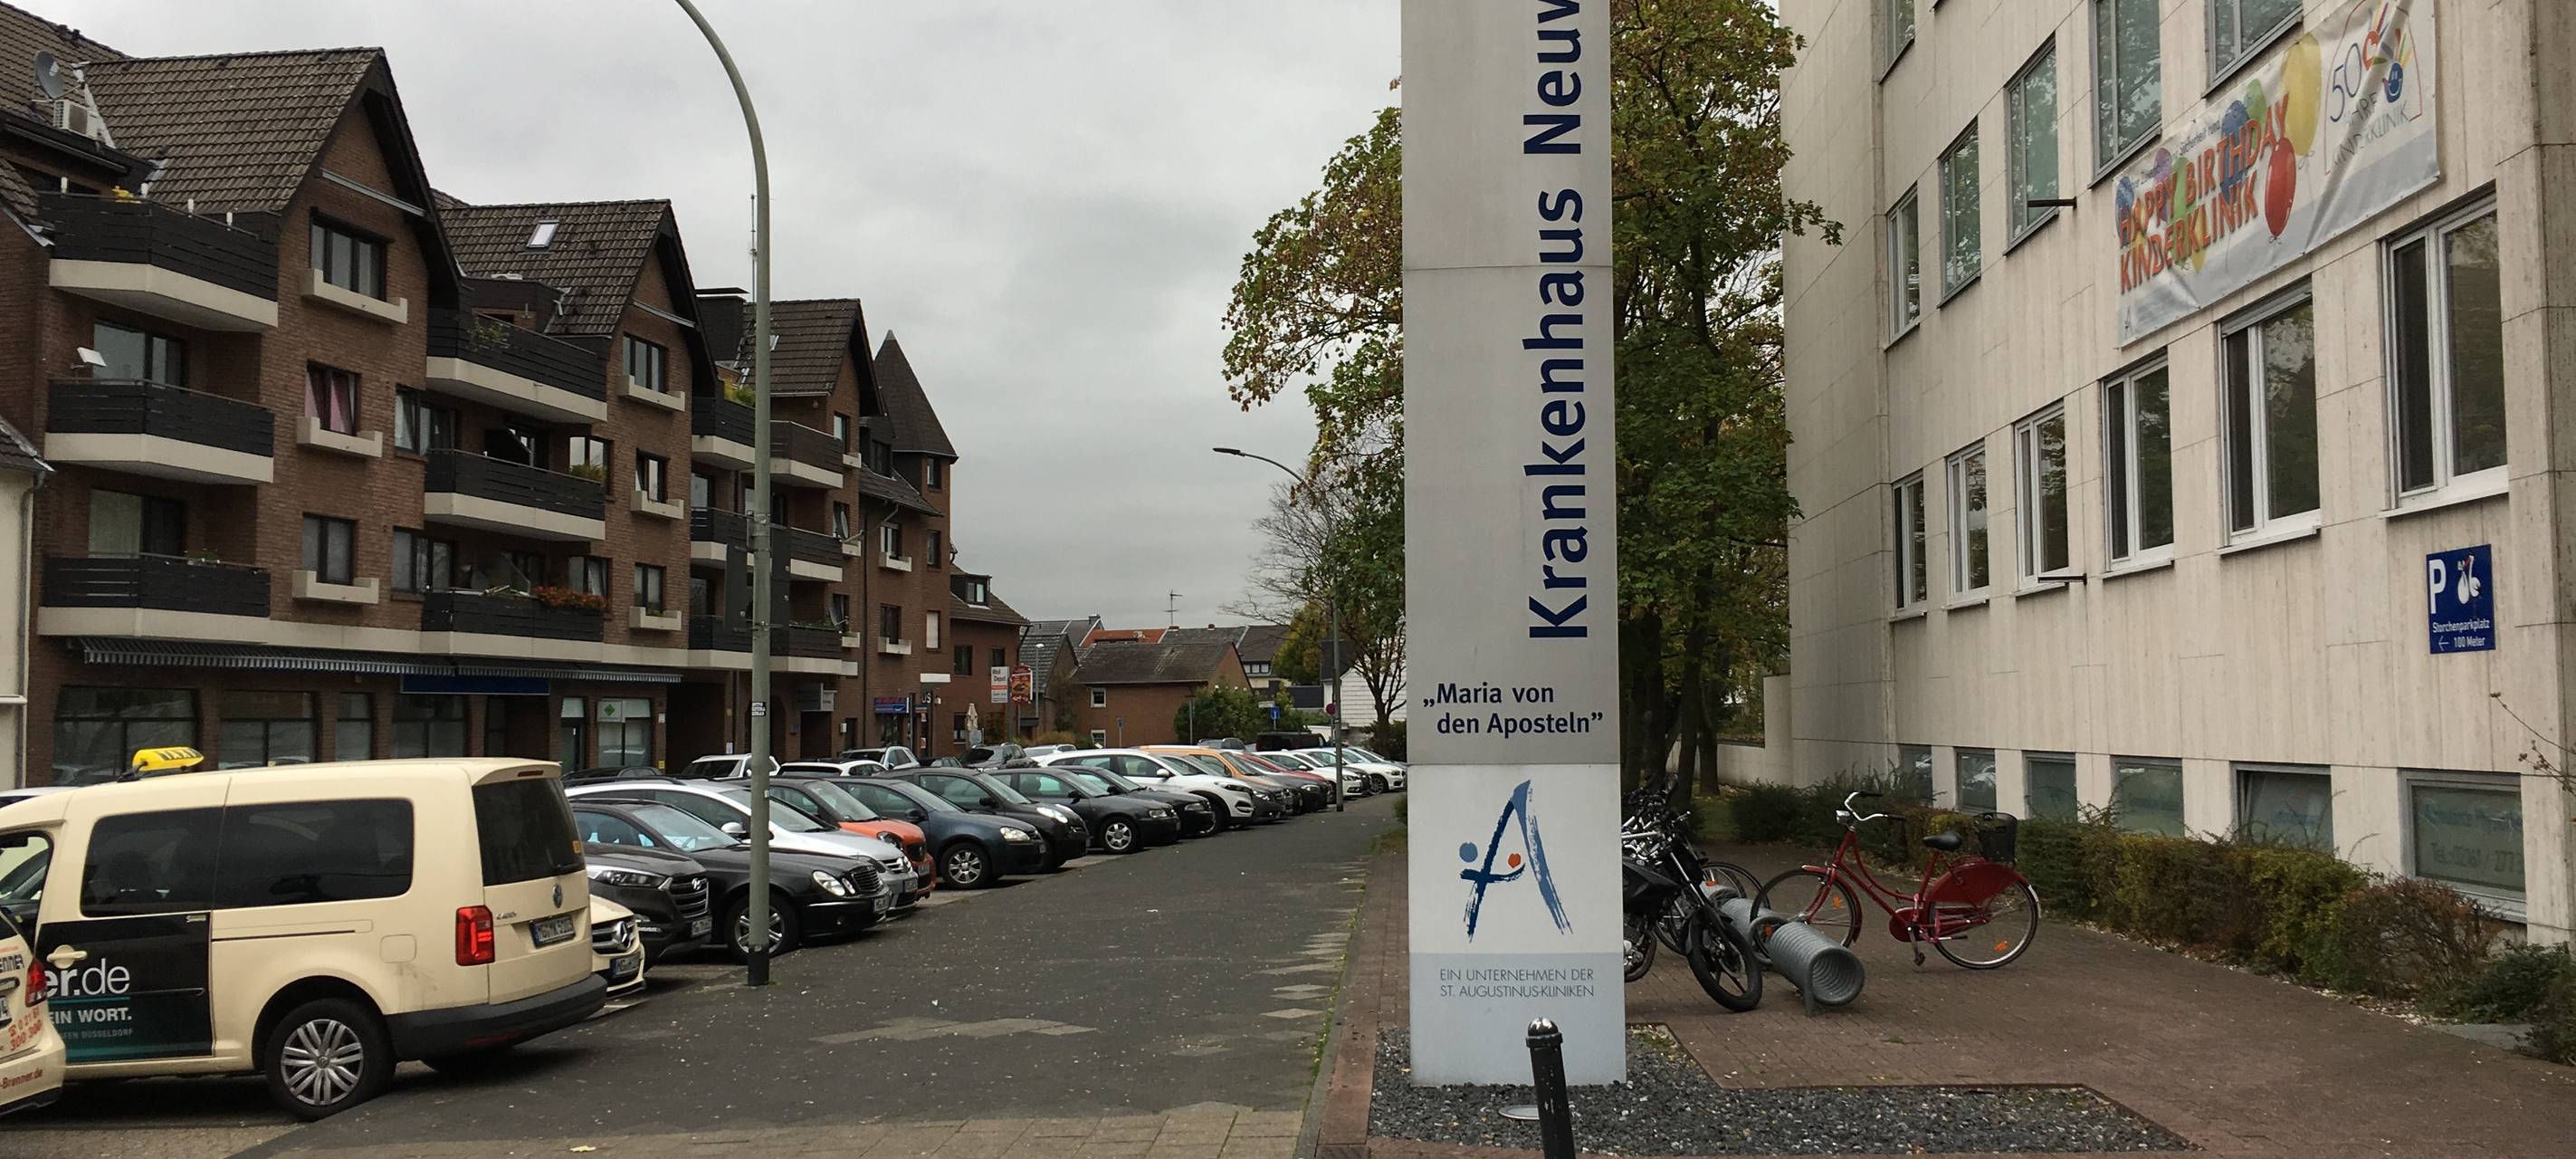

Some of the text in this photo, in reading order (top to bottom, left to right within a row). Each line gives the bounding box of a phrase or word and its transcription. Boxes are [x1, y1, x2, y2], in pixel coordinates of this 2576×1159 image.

[2120, 172, 2178, 249] HAPPY
[2186, 93, 2288, 206] BIRTHDAY
[2121, 170, 2259, 295] KINDERKLINIK
[1522, 188, 1588, 637] Krankenhaus
[2429, 559, 2447, 614] P
[2432, 618, 2490, 633] Storchenparkplatz
[2454, 637, 2485, 647] 100 Meter
[1512, 686, 1554, 704] von
[1436, 714, 1480, 733] den
[156, 749, 198, 761] TAXI
[1440, 969, 1594, 981] EIN UNTERNEHMEN DER
[1440, 984, 1594, 997] ST. AUGUSTINUS-KLINIKEN
[77, 1007, 132, 1022] WORT.
